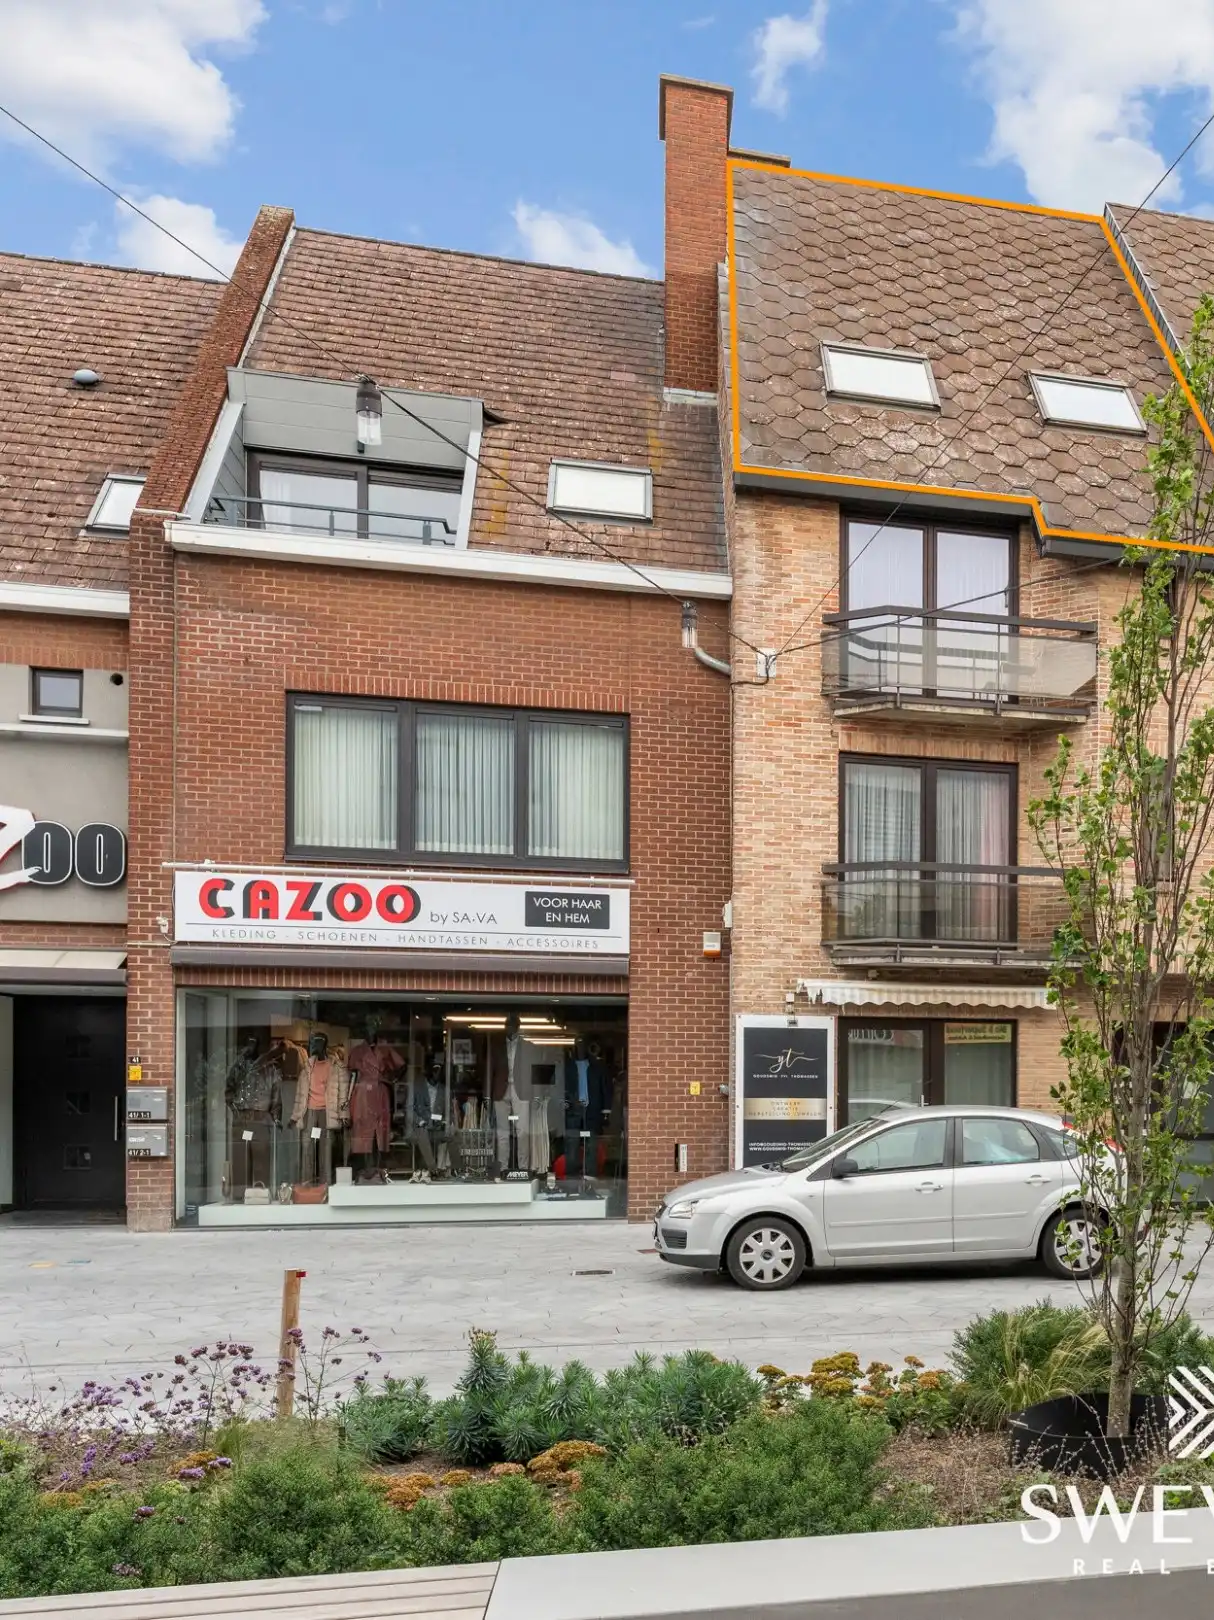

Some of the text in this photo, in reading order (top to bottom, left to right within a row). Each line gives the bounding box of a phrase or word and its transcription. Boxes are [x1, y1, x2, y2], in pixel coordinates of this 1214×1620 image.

[199, 878, 421, 924] CAZOO
[533, 897, 602, 910] VOOR HAAR
[430, 911, 448, 928] by
[545, 912, 590, 924] EN HEM
[212, 928, 277, 940] KLEDING
[297, 931, 378, 942] SCHOENEN
[397, 934, 488, 946] HANDTASSEN
[507, 937, 598, 949] ACCESSOIRES
